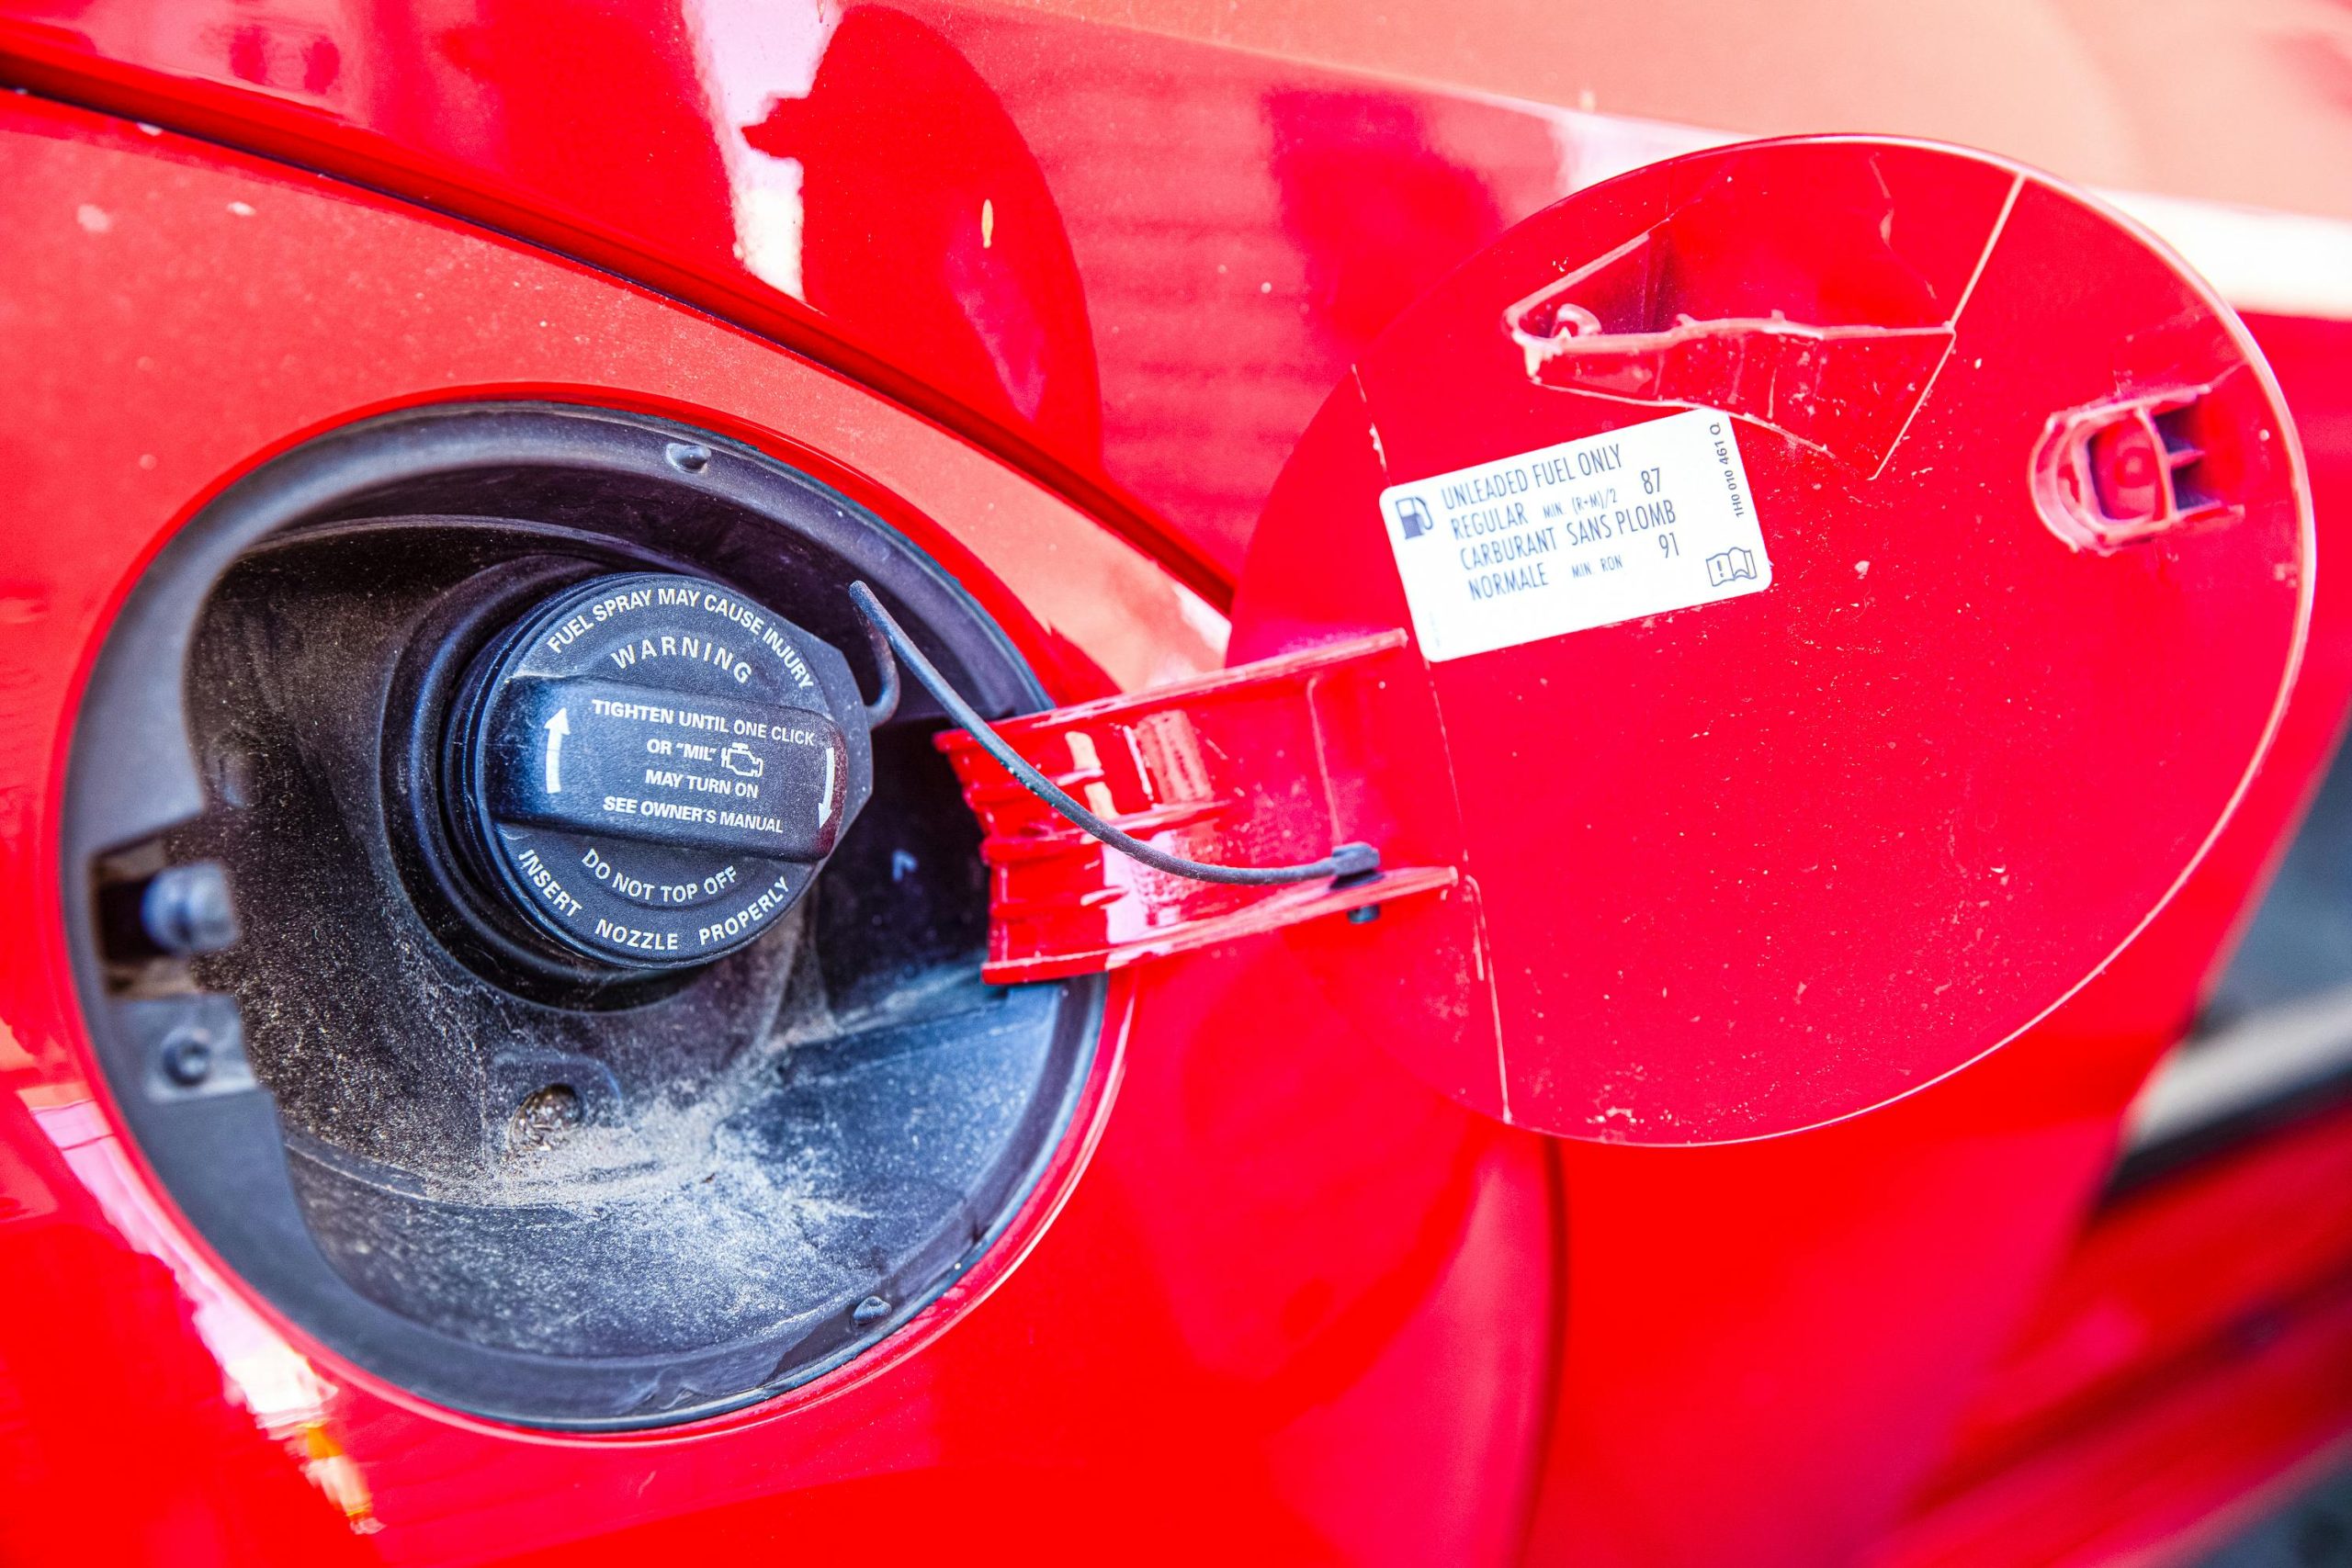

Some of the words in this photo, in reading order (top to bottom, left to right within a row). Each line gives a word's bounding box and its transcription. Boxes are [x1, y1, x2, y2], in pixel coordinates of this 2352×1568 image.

[1709, 423, 1721, 435] Q
[1714, 441, 1729, 465] 461
[1441, 468, 1529, 510] UNLEADED
[1532, 457, 1576, 488] FUEL
[1578, 444, 1622, 476] ONLY
[1724, 469, 1737, 491] 010
[1451, 502, 1528, 540] REGULAR
[1641, 468, 1660, 495] 87
[1461, 526, 1556, 570] CARBURANT
[1566, 514, 1611, 546] SANS
[1615, 500, 1677, 536] PLOMB
[1468, 562, 1549, 601] NORMALE
[1600, 554, 1623, 573] RON
[1658, 532, 1679, 558] 91
[547, 615, 594, 654] FUEL
[592, 589, 652, 622] SPRAY
[658, 588, 700, 607] MAY
[704, 593, 764, 636] CAUSE
[762, 626, 814, 690] INJURY
[610, 636, 752, 683] WARNING
[592, 699, 674, 725] TIGHTEN
[678, 713, 729, 734] UNTIL
[733, 720, 767, 739] ONE
[771, 726, 815, 746] CLICK
[647, 739, 672, 755] OR
[645, 770, 684, 788] MAY
[687, 775, 731, 795] TURN
[735, 783, 759, 799] ON
[603, 796, 638, 814] SEE
[640, 801, 717, 824] OWNER'S
[720, 812, 784, 833] MANUAL
[582, 848, 611, 879] DO
[612, 873, 655, 900] NOT
[661, 883, 698, 902] TOP
[704, 865, 736, 895] OFF
[518, 849, 582, 917] INSERT
[594, 919, 678, 951] NOZZLE
[698, 876, 789, 946] PROPERLY
